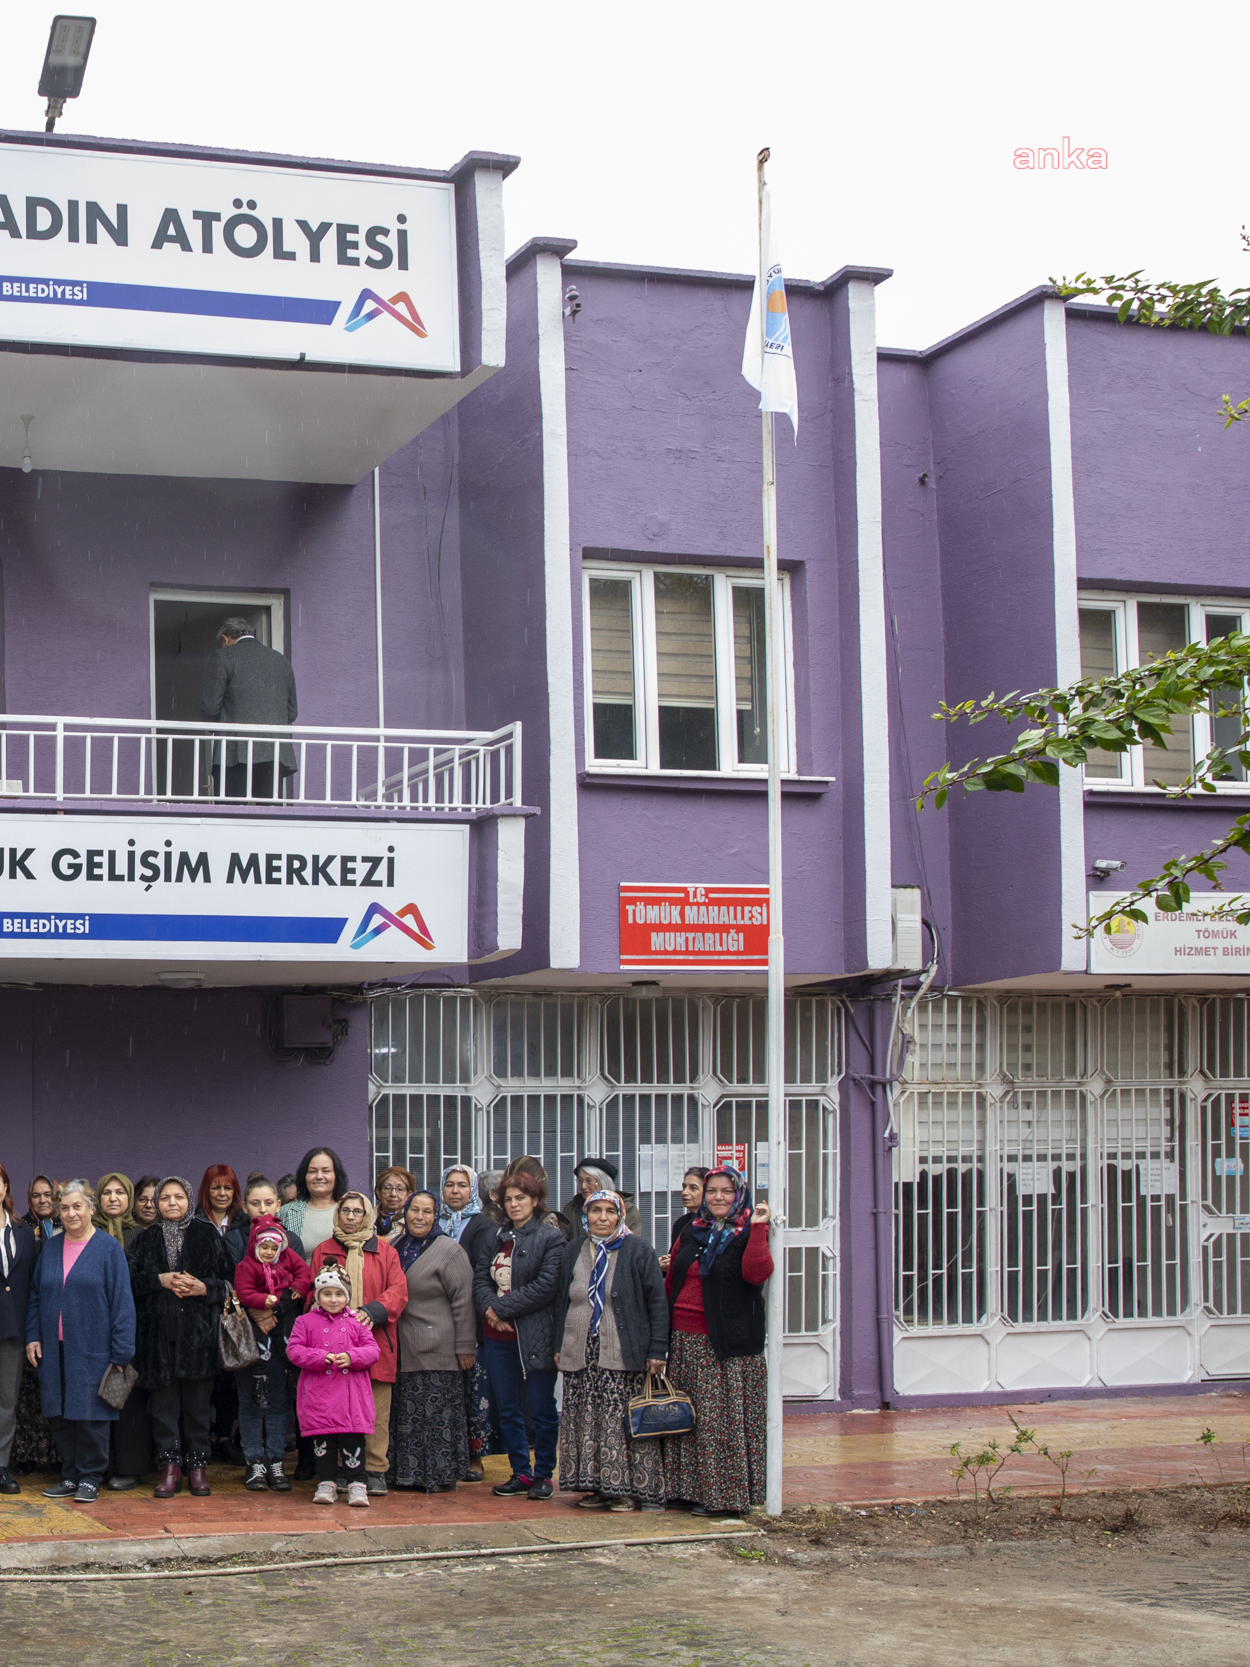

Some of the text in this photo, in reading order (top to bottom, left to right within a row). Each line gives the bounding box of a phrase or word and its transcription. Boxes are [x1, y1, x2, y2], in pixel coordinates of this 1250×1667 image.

[150, 198, 409, 271] ATÖLYESİ
[2, 279, 88, 302] BELEDİYESİ
[51, 838, 212, 893] GELİŞİM
[225, 845, 395, 888] MERKEZİ
[687, 887, 709, 903] T.C.
[3, 915, 90, 934] BELEDİYESİ
[626, 902, 768, 925] TÖMÜK MAHALLESİ
[651, 929, 744, 951] MUHTARLIĞI
[1195, 927, 1238, 939] TÖMÜK
[1174, 944, 1219, 956] HİZMET
